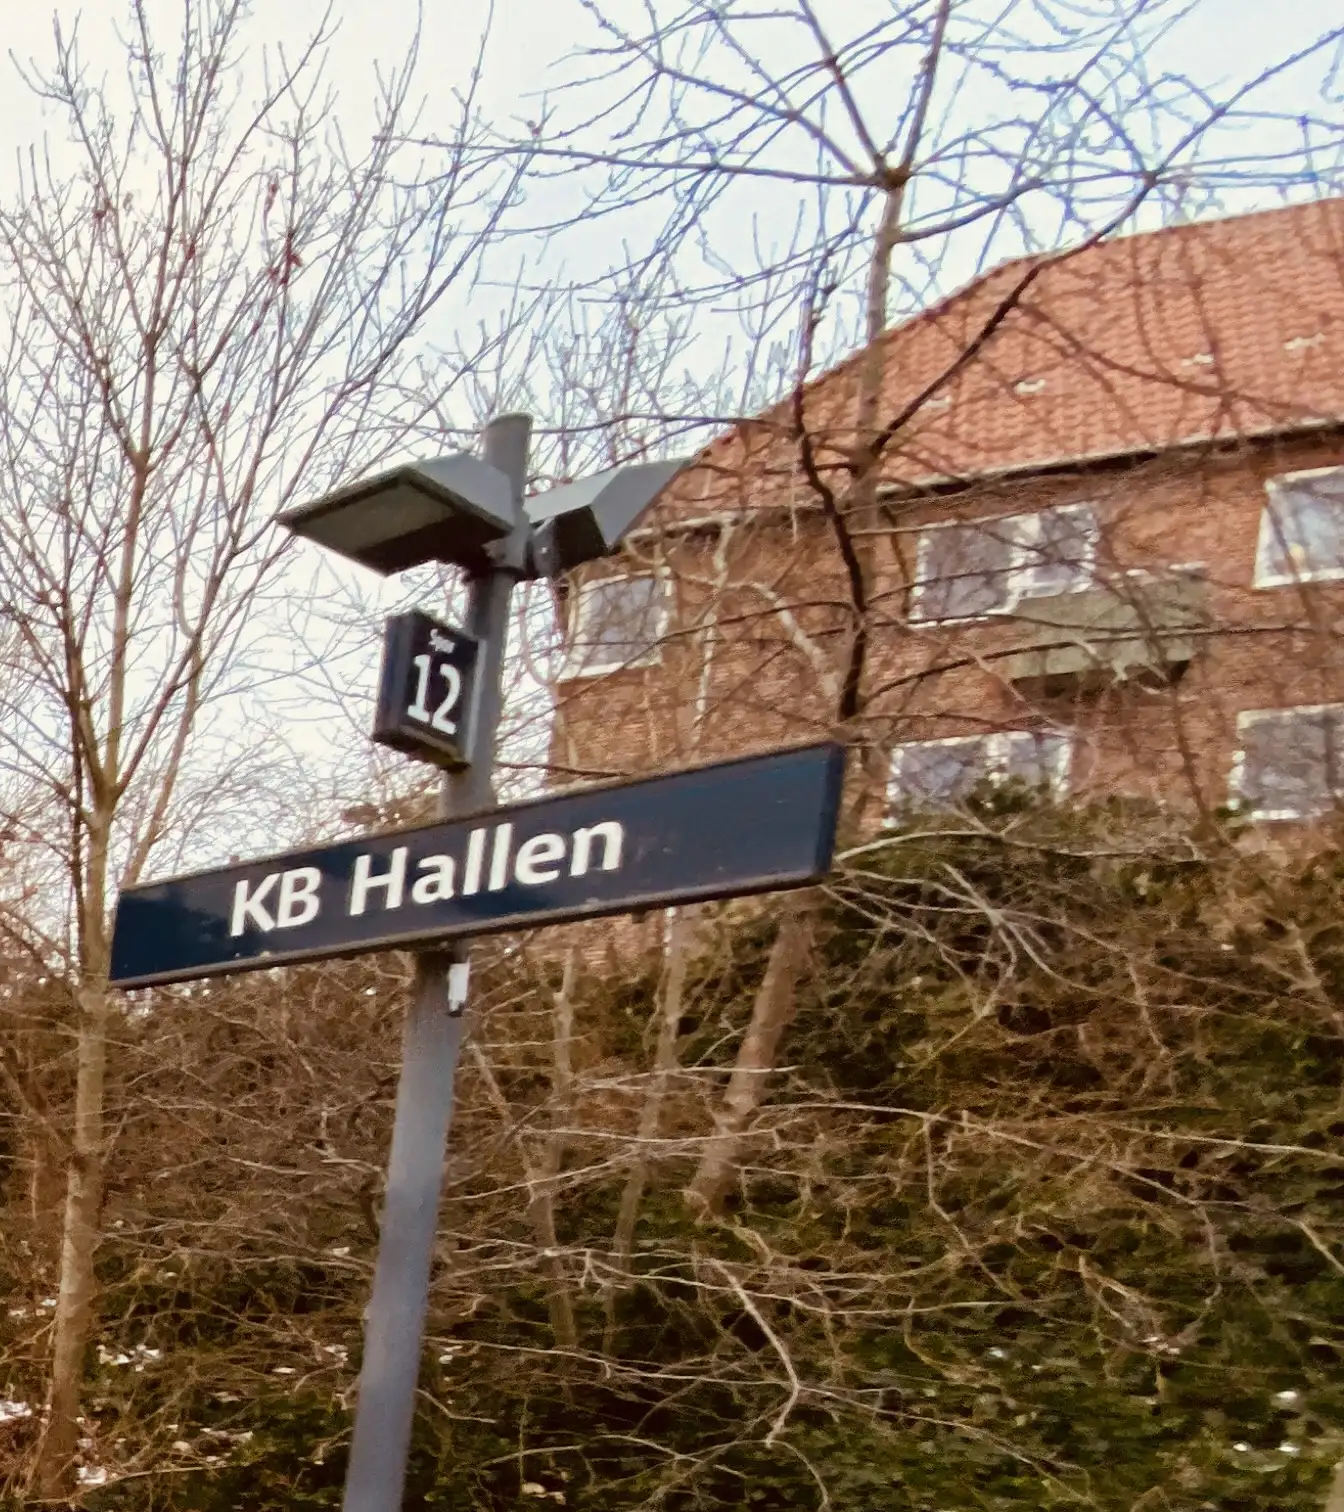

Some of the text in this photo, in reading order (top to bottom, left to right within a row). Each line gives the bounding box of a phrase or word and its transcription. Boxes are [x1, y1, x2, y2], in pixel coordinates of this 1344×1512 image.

[406, 654, 461, 735] 12
[229, 820, 625, 938] KB Hallen
